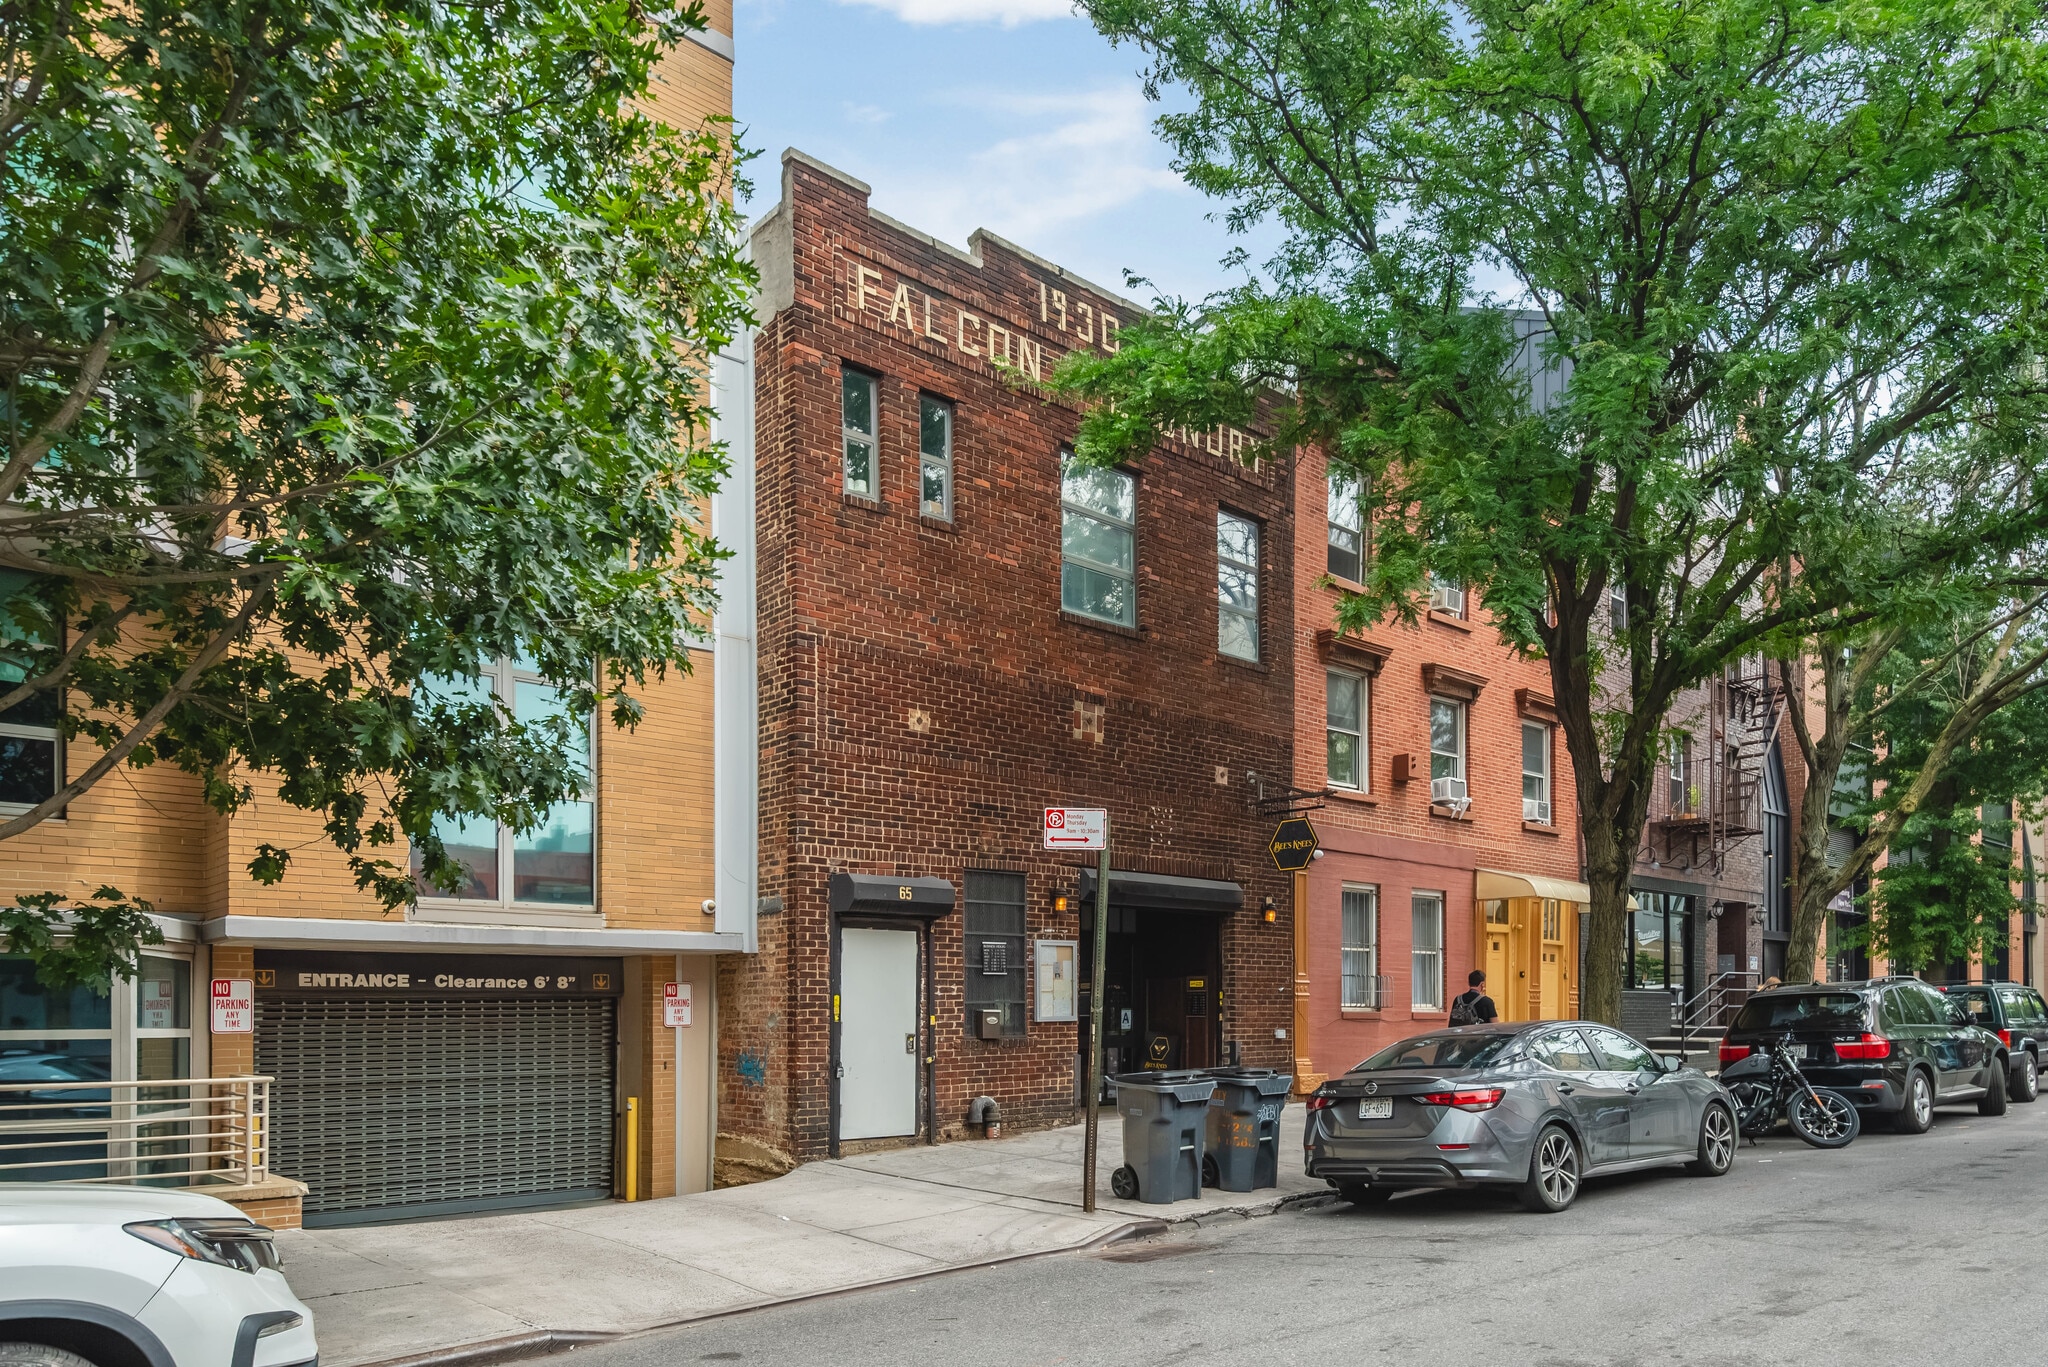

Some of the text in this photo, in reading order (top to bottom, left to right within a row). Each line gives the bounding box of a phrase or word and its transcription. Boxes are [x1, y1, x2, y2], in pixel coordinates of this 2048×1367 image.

[1040, 281, 1119, 353] 1930
[856, 264, 1040, 382] FALCON
[1293, 839, 1313, 850] KNEES
[899, 886, 912, 900] 65
[298, 973, 410, 988] ENTRANCE
[434, 974, 528, 989] Clearance
[215, 983, 229, 994] NO
[667, 985, 676, 996] NO
[215, 999, 249, 1010] PARKING
[667, 999, 690, 1007] PARKING
[225, 1011, 239, 1019] ANY
[1122, 1012, 1130, 1024] A
[225, 1020, 241, 1028] TIME
